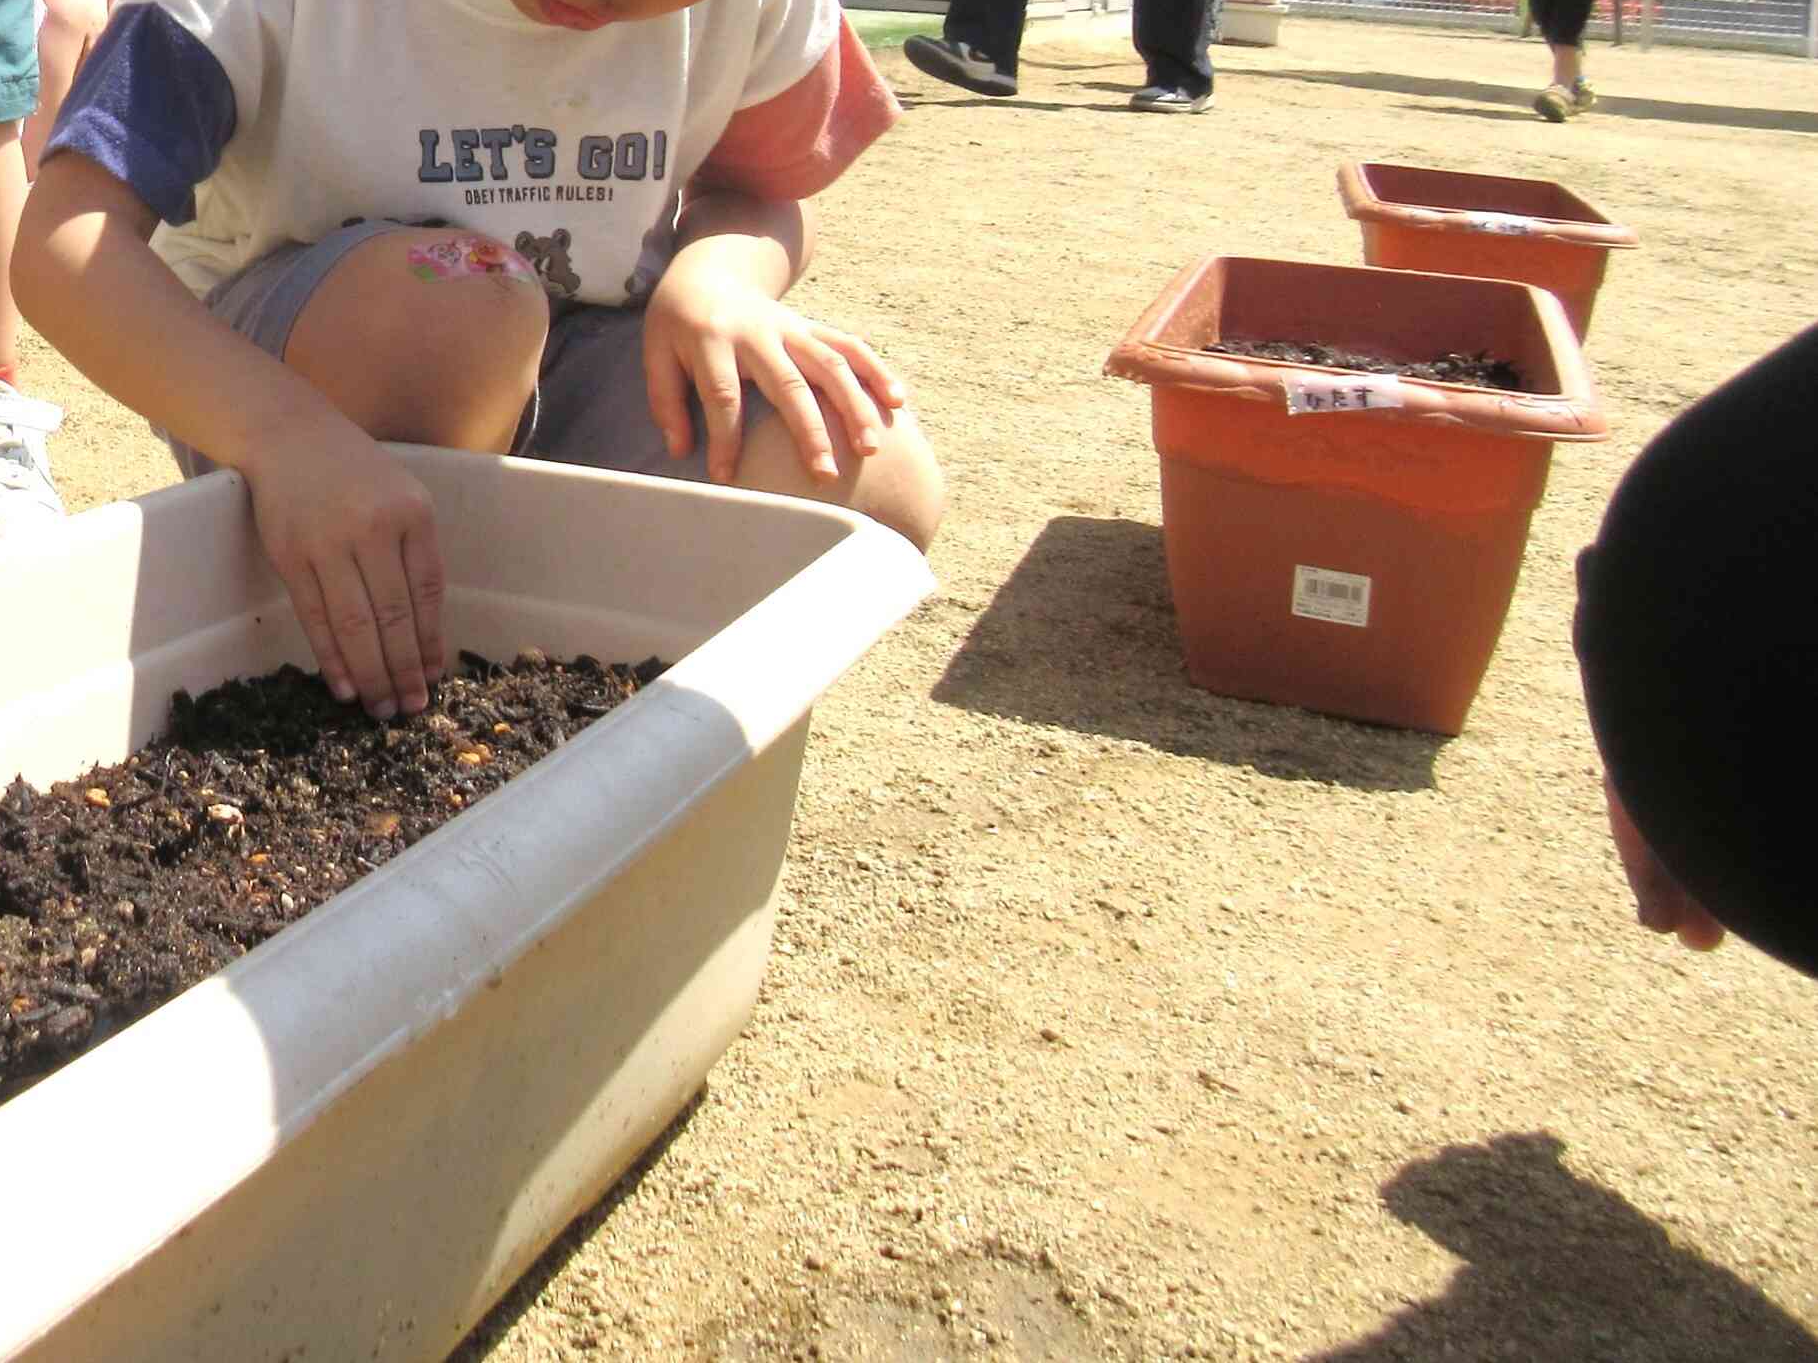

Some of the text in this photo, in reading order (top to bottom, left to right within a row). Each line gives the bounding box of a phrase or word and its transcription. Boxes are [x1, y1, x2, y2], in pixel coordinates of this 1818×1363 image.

[418, 124, 668, 183] LET'S GO!
[464, 186, 614, 205] OBEY TRAFFIC RULES!
